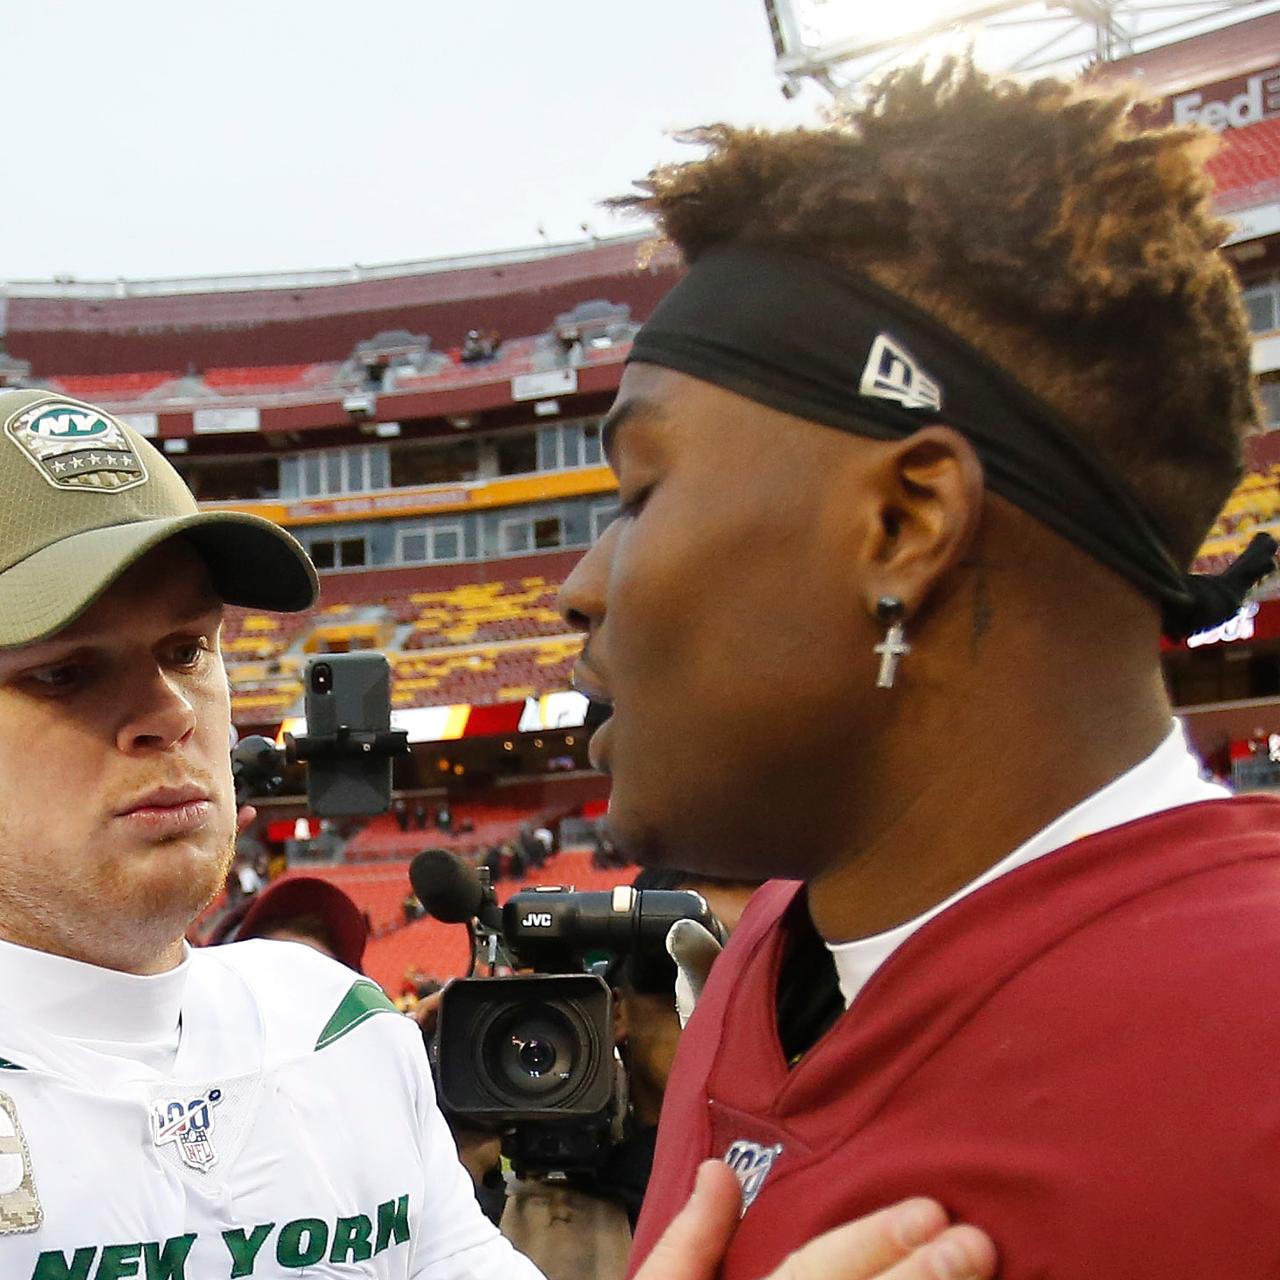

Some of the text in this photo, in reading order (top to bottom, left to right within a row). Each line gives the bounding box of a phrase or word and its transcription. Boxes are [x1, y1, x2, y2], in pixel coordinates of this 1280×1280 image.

[39, 413, 99, 437] NY
[522, 912, 552, 927] JVC
[186, 1142, 212, 1163] NFL
[221, 1193, 411, 1280] YORK
